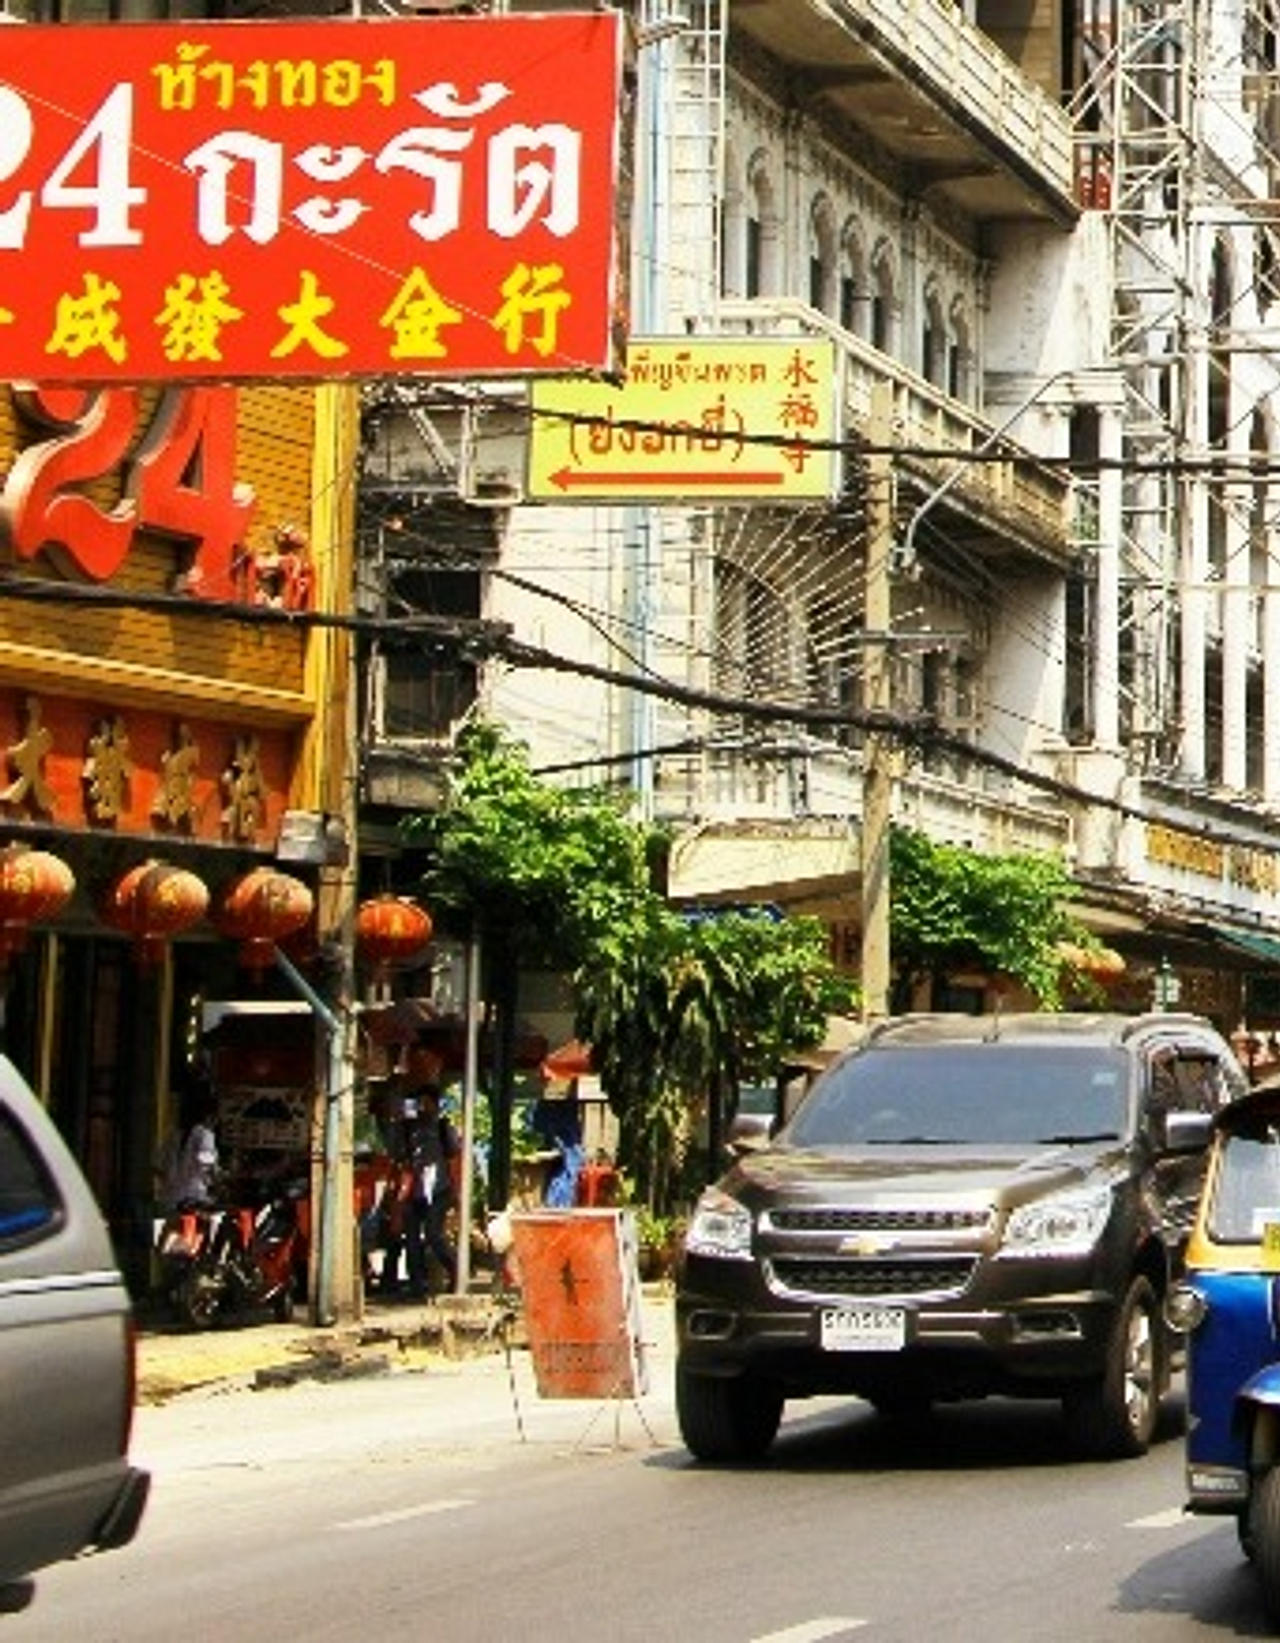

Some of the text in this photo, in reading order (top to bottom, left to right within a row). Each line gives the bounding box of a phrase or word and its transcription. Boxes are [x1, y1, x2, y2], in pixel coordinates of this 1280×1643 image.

[151, 40, 398, 112] ห้างทอง
[181, 80, 584, 246] กะรัต
